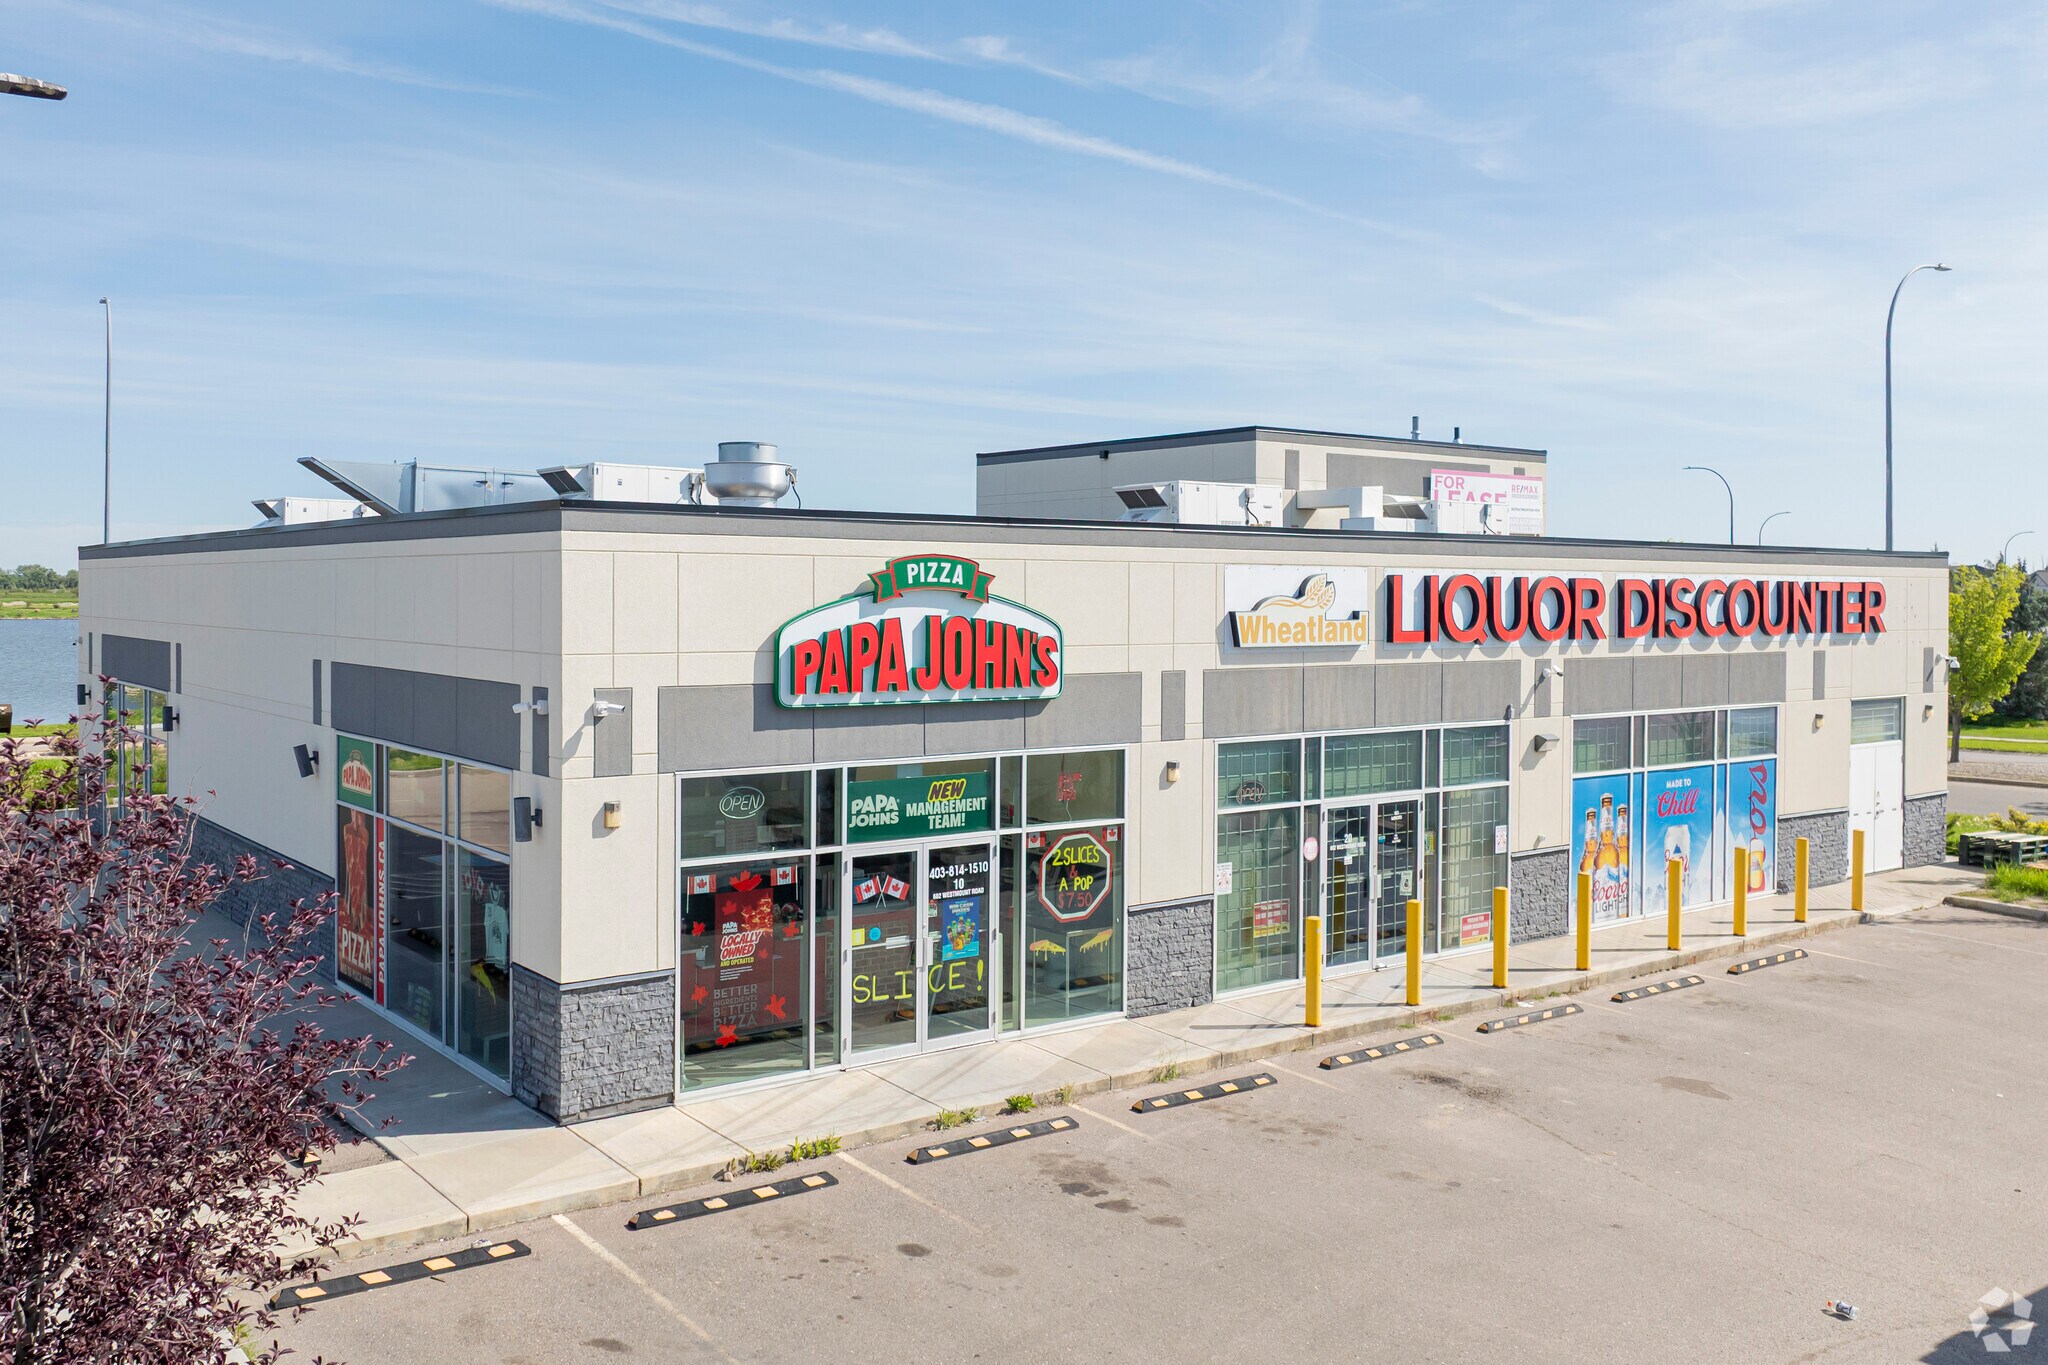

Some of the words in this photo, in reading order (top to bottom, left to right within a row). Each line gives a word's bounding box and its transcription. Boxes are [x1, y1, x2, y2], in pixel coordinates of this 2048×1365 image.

[1434, 475, 1465, 490] FOR
[1511, 484, 1539, 495] RE/MAX
[907, 562, 963, 586] PIZZA
[1386, 573, 1607, 645] LIQUOR
[1617, 577, 1887, 639] DISCOUNTER
[1238, 614, 1367, 644] Wheatland
[790, 617, 909, 695] PAPA
[912, 614, 1060, 692] JOHN'S
[928, 778, 966, 802] NEW
[1665, 779, 1683, 789] MADE
[1683, 778, 1692, 787] TO
[721, 794, 760, 812] OPEN
[851, 794, 899, 814] PAPA
[905, 797, 987, 817] MANAGEMENT
[1657, 787, 1700, 818] Chill
[849, 811, 900, 828] JOHNS
[928, 812, 966, 829] TEAM!
[1344, 833, 1353, 844] 20
[1052, 848, 1063, 867] 2
[1063, 845, 1100, 866] SLICES
[929, 861, 989, 879] 403-814-1510
[1069, 865, 1079, 878] &
[954, 878, 964, 889] 10
[1058, 877, 1069, 892] A
[1073, 875, 1094, 892] POP
[942, 888, 971, 899] WESTMOUNT
[972, 887, 984, 895] ROAD
[721, 930, 762, 949] LOCALLY
[342, 927, 372, 974] PIZZA
[721, 943, 755, 960] OWNED
[713, 983, 758, 1000] BETTER
[713, 994, 758, 1007] INGREDIENTS
[713, 1001, 758, 1018] BETTER
